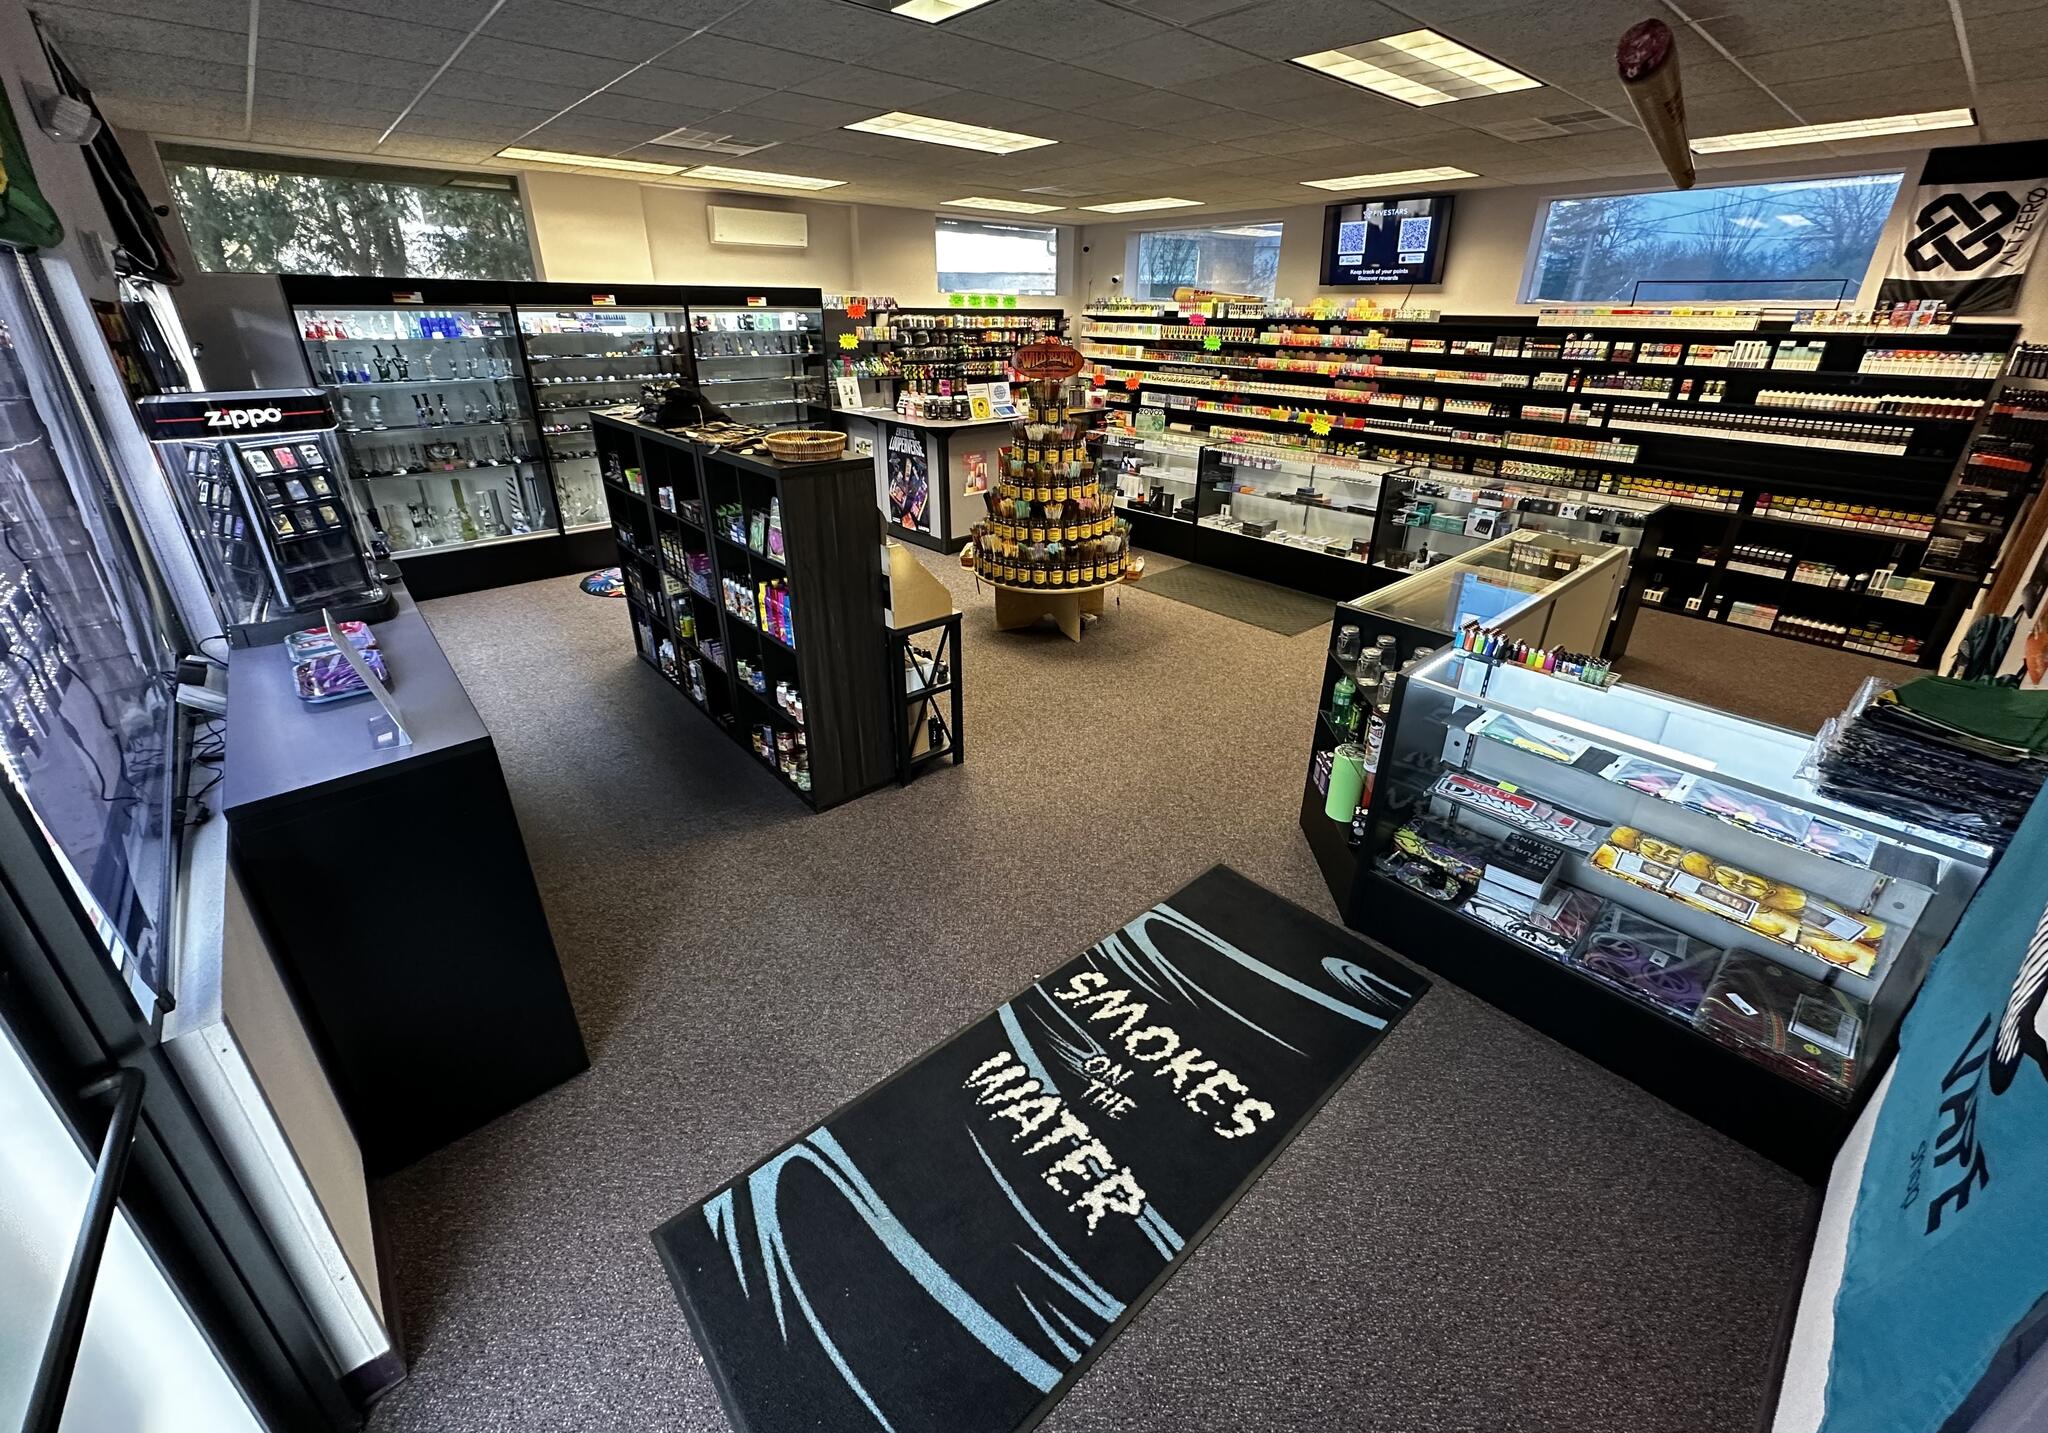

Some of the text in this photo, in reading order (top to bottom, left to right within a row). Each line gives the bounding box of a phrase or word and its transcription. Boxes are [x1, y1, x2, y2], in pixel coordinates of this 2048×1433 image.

[1373, 207, 1408, 216] FIVESTARS
[1510, 845, 1554, 864] FUTURE
[1511, 834, 1561, 855] ROLLING
[1541, 851, 1557, 859] OF
[1526, 857, 1550, 869] THE
[1053, 971, 1276, 1139] SMOKES
[1084, 1055, 1135, 1086] ON
[1080, 1078, 1137, 1120] THE
[962, 1050, 1146, 1237] WATER
